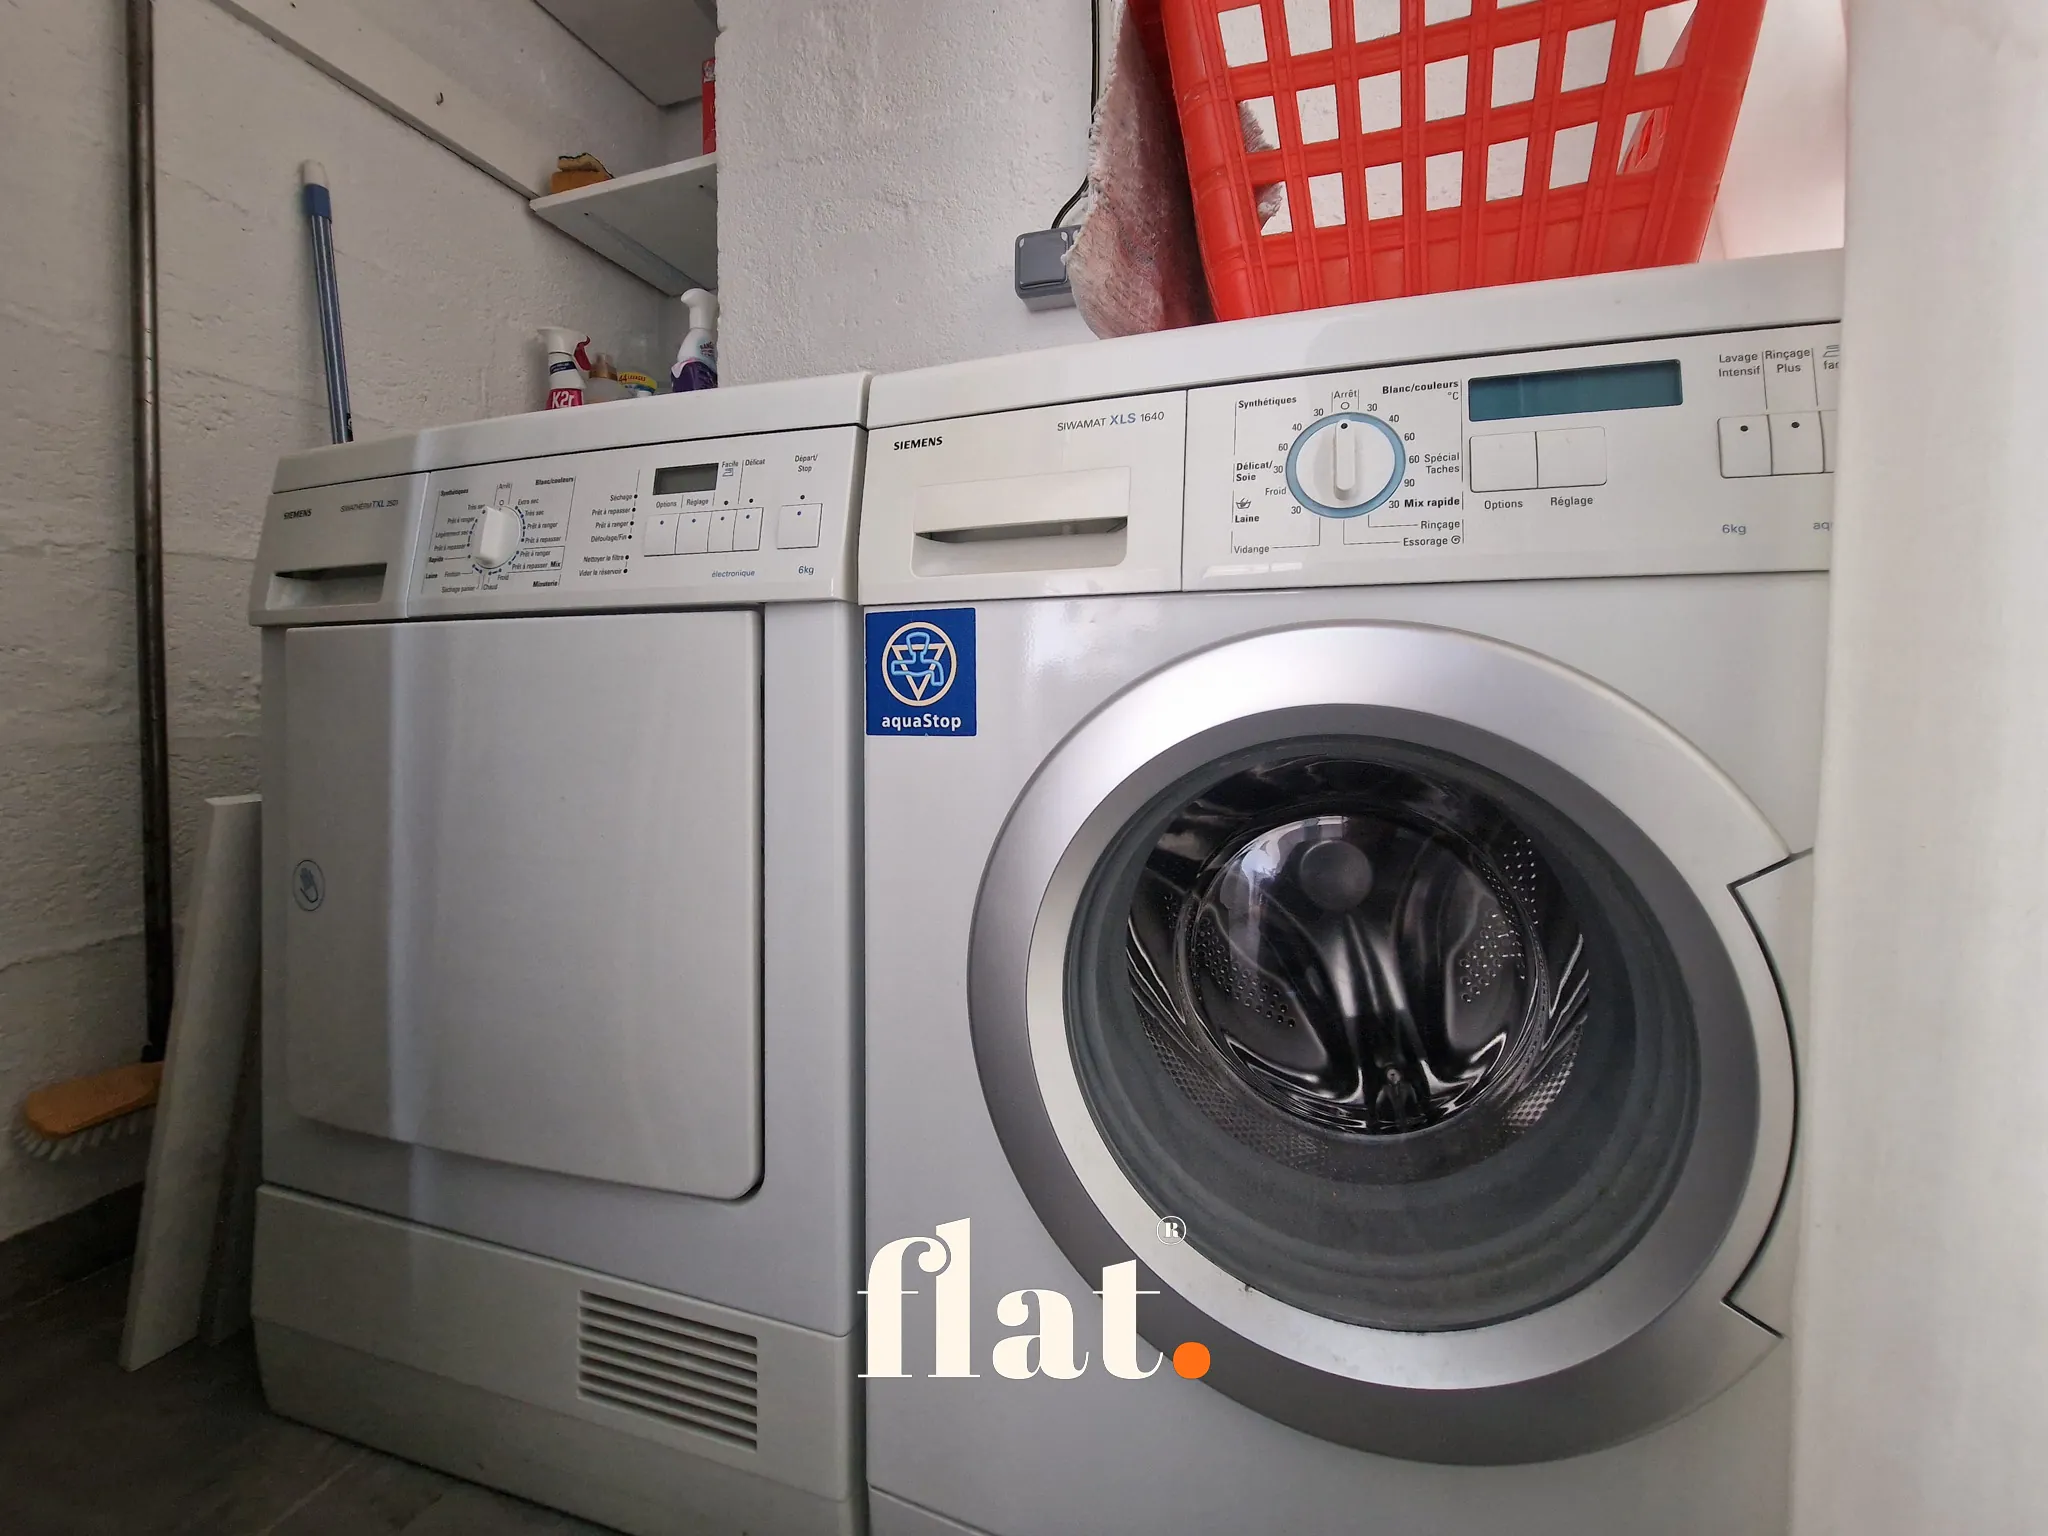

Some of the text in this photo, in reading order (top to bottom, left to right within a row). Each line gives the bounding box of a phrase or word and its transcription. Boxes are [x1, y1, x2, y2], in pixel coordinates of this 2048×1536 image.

[1719, 353, 1758, 363] Lavage
[1765, 349, 1810, 360] Rinçage
[1719, 366, 1761, 377] Intensif
[1777, 363, 1801, 373] Plus
[1382, 381, 1459, 394] Blanc/couleurs
[1333, 389, 1357, 399] Arrêt
[1447, 391, 1459, 400] °C
[552, 391, 574, 408] K2r
[1238, 397, 1297, 409] Synthétiques
[1313, 408, 1324, 417] 30
[1366, 403, 1378, 412] 30
[1057, 411, 1165, 432] SIWAMAT XLS 1640
[1388, 415, 1400, 423] 40
[1292, 423, 1302, 431] 40
[1404, 432, 1415, 441] 60
[893, 436, 943, 451] SIEMENS
[1278, 443, 1288, 451] 60
[795, 454, 818, 464] Départ/
[1408, 453, 1460, 464] 60 Spécial
[722, 460, 739, 468] Facile
[798, 465, 812, 473] Stop
[1236, 460, 1273, 471] Délicat/
[1273, 465, 1284, 474] 30
[1426, 464, 1460, 475] Taches
[1236, 473, 1256, 482] Soie
[1403, 478, 1415, 488] 90
[1265, 486, 1287, 496] Froid
[656, 500, 677, 508] Options
[686, 498, 709, 507] Réglage
[1389, 497, 1460, 509] 30 Mix rapide
[1484, 499, 1523, 511] Options
[1550, 495, 1593, 508] Réglage
[283, 509, 312, 520] SIEMENS
[1291, 505, 1301, 514] 30
[1235, 515, 1260, 524] Laine
[1420, 520, 1460, 531] Rinçage
[1722, 523, 1747, 536] 6kg
[1403, 537, 1448, 548] Essorage
[1234, 545, 1270, 555] Vidange
[711, 569, 756, 578] électronique
[798, 565, 815, 575] 6kg
[881, 713, 962, 732] aquaStop
